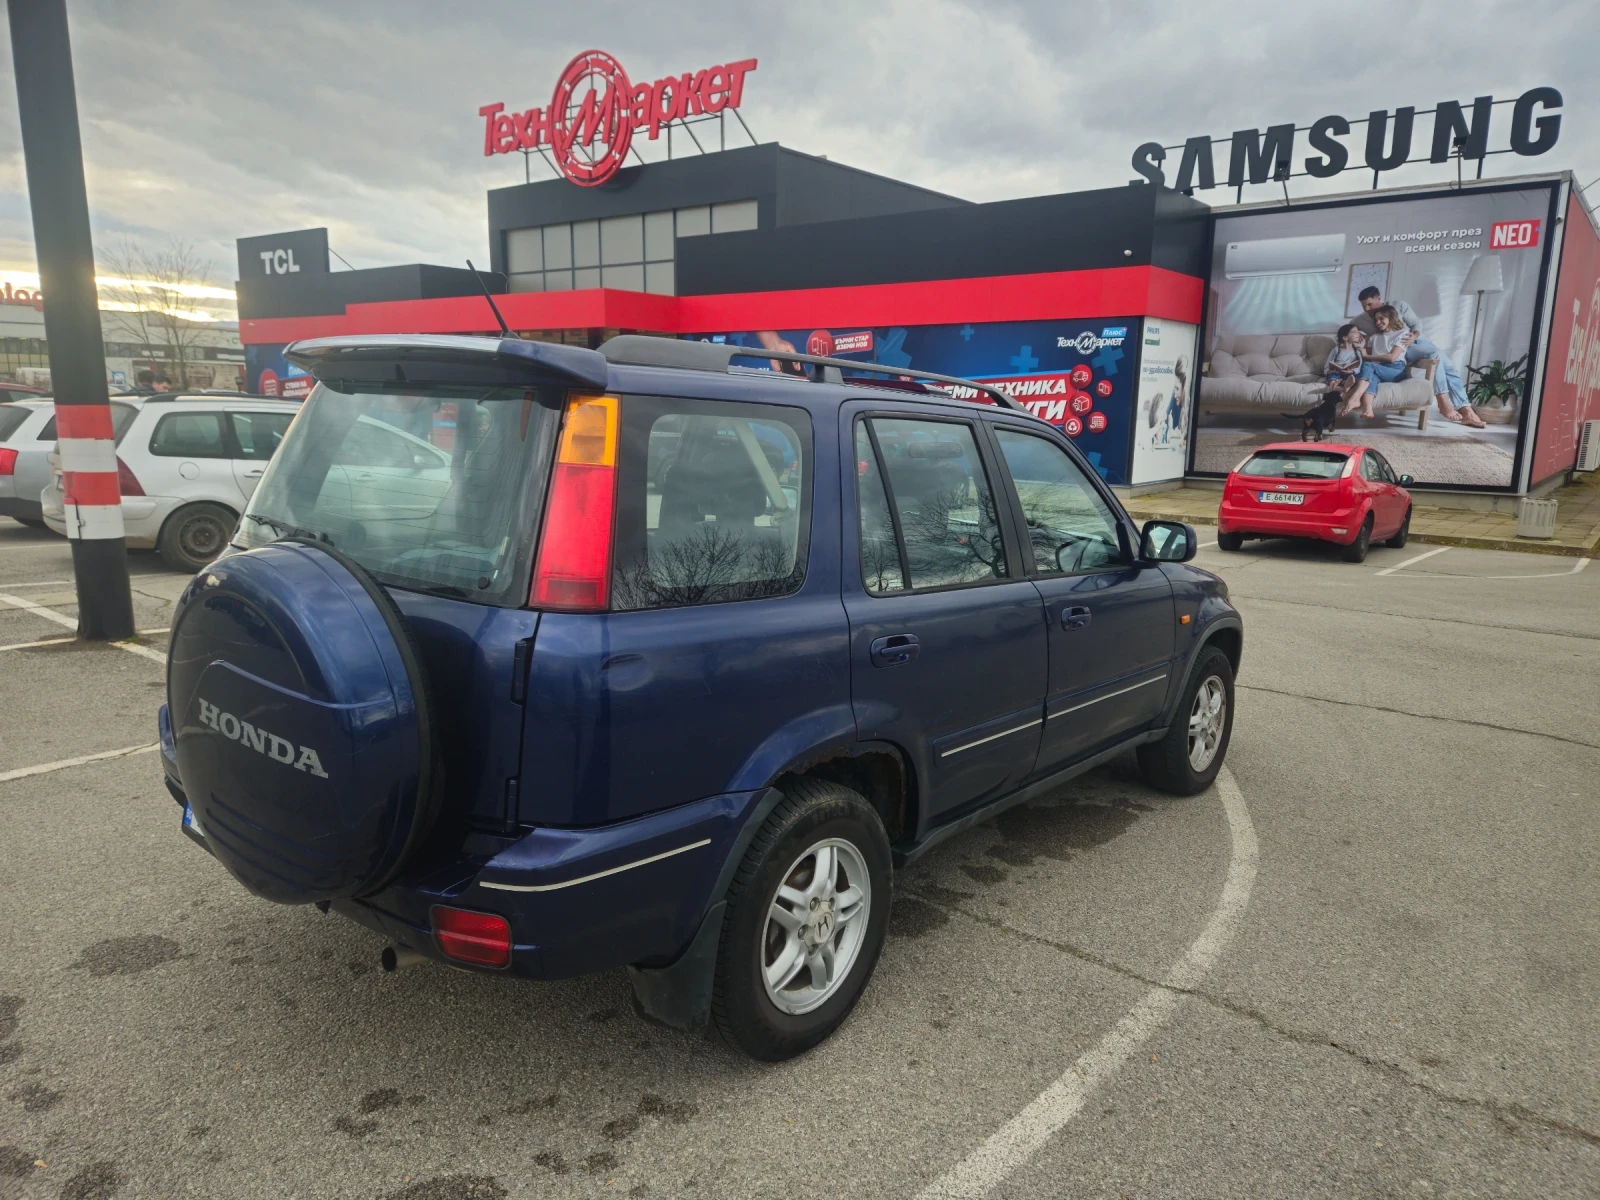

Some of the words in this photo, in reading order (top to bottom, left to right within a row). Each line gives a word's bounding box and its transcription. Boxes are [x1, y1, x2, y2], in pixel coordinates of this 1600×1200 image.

[1129, 86, 1564, 191] SAMSUNG
[1356, 235, 1380, 244] Уют
[1393, 229, 1448, 242] комфорт
[1452, 227, 1482, 238] през
[1405, 242, 1440, 253] всеки
[1444, 240, 1481, 250] сезон
[1493, 223, 1532, 247] NEO
[260, 249, 300, 275] TCL
[198, 697, 329, 779] HONDA
